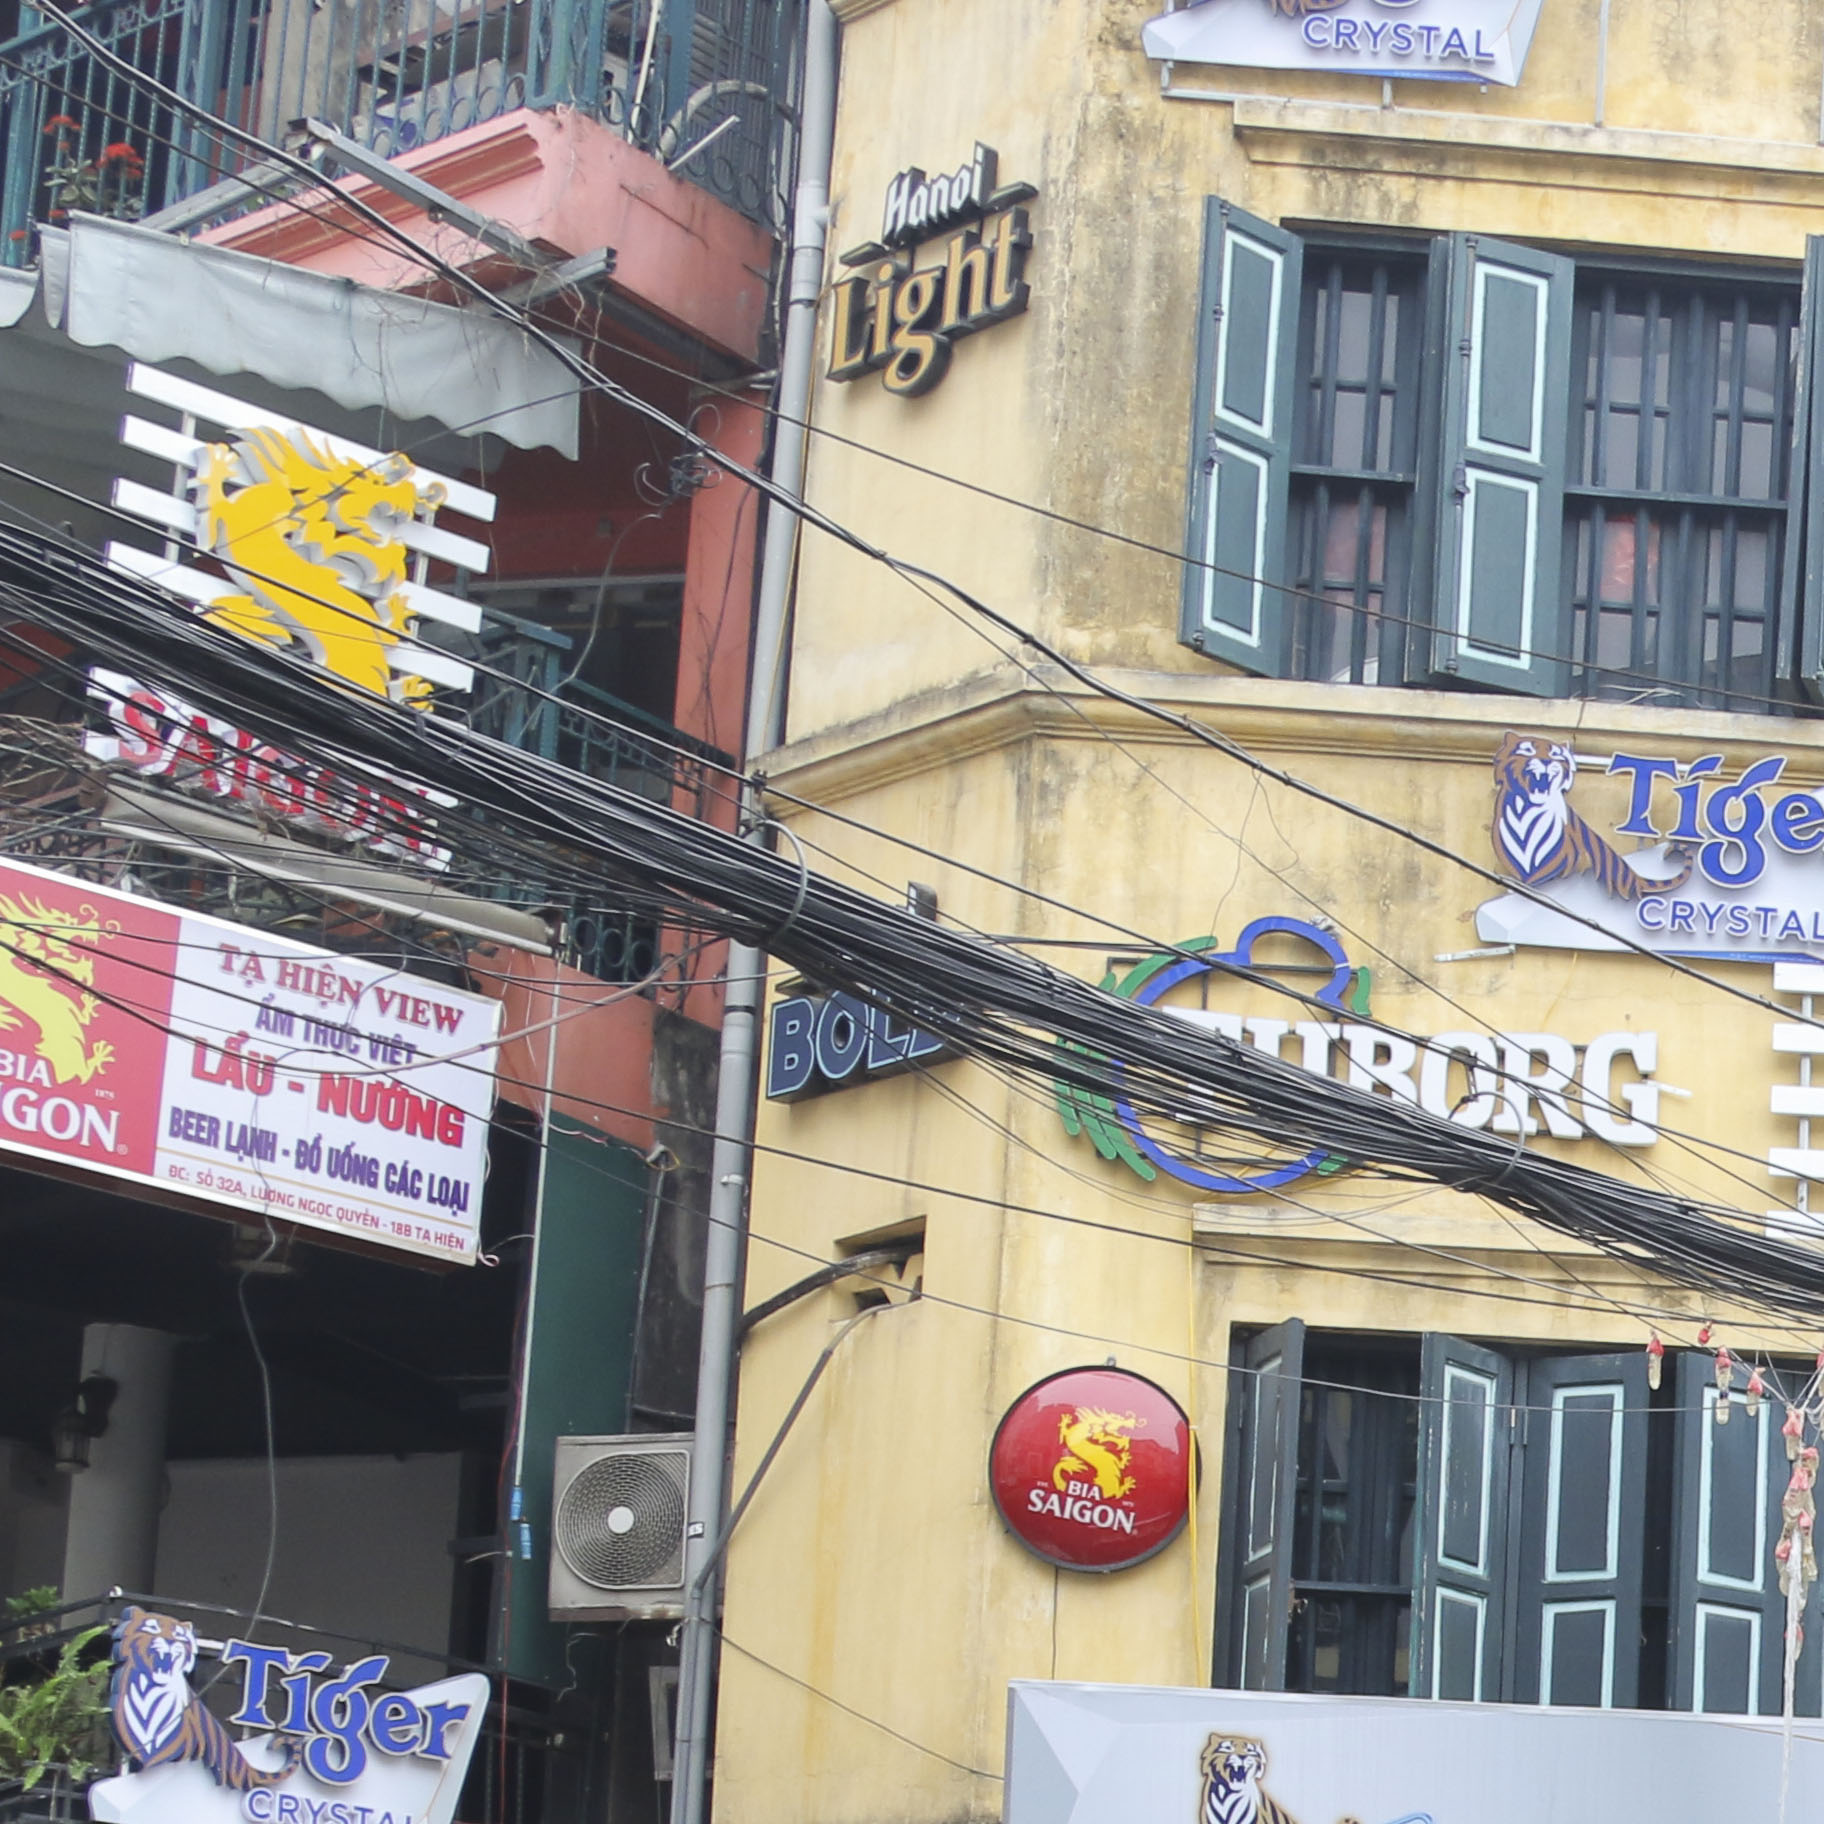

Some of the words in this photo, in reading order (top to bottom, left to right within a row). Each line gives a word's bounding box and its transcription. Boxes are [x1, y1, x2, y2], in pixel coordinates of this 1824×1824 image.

[1302, 15, 1496, 64] CRYSTAL
[884, 141, 996, 245] Hanoi
[826, 207, 1033, 399] Light
[219, 944, 266, 980] TẠ
[277, 957, 363, 1007] HIỆN
[364, 987, 464, 1035] VIEW
[368, 1030, 418, 1066] VIỆT
[317, 1070, 465, 1149] NƯỚNG
[169, 1106, 219, 1149] BEER
[224, 1120, 278, 1166] LẠNH
[327, 1142, 379, 1189] UỐNG
[385, 1160, 423, 1200] CÁC
[427, 1174, 470, 1217] LOẠI
[1027, 1489, 1135, 1535] SAIGON
[1068, 1480, 1101, 1501] BIA
[224, 1638, 470, 1785] Tiger
